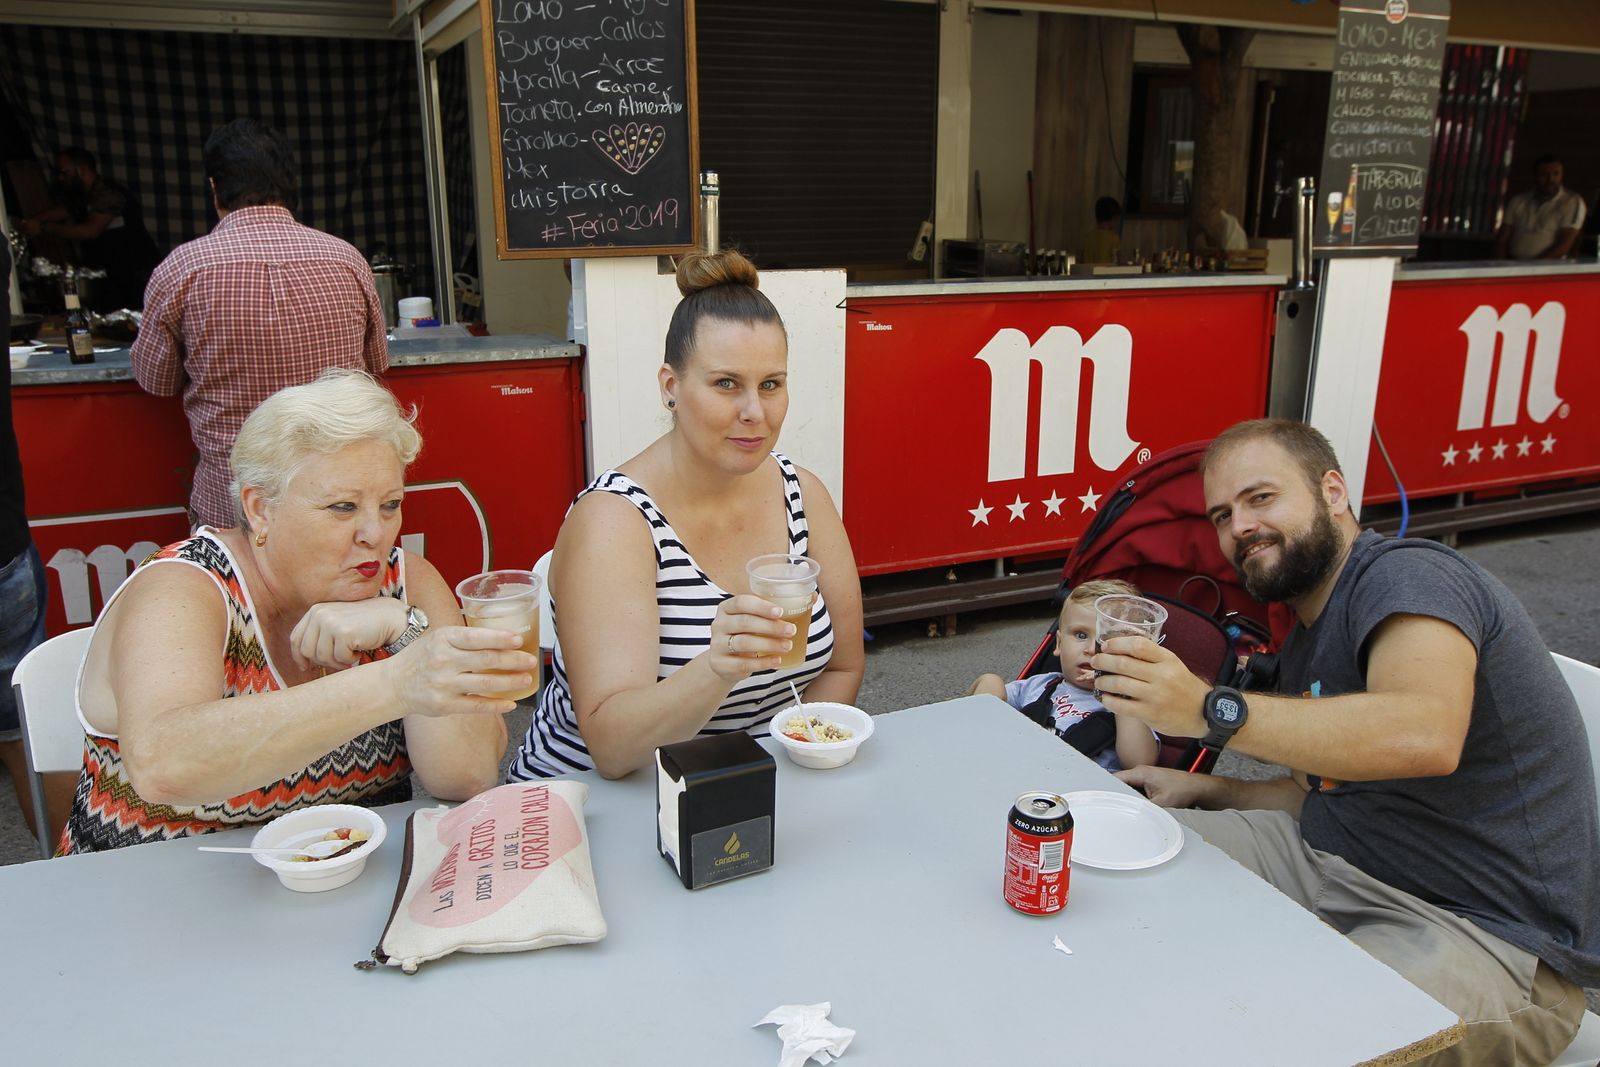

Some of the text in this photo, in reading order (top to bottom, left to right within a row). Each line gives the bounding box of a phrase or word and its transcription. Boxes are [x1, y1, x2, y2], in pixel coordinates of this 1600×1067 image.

[600, 16, 666, 42] Callos
[520, 784, 549, 814] CALLA
[1014, 818, 1059, 833] ZERO AZÚCAR
[468, 819, 496, 901] DICEN A GRITOS
[503, 831, 519, 871] LO QUE EL
[714, 851, 750, 866] CANDELAS
